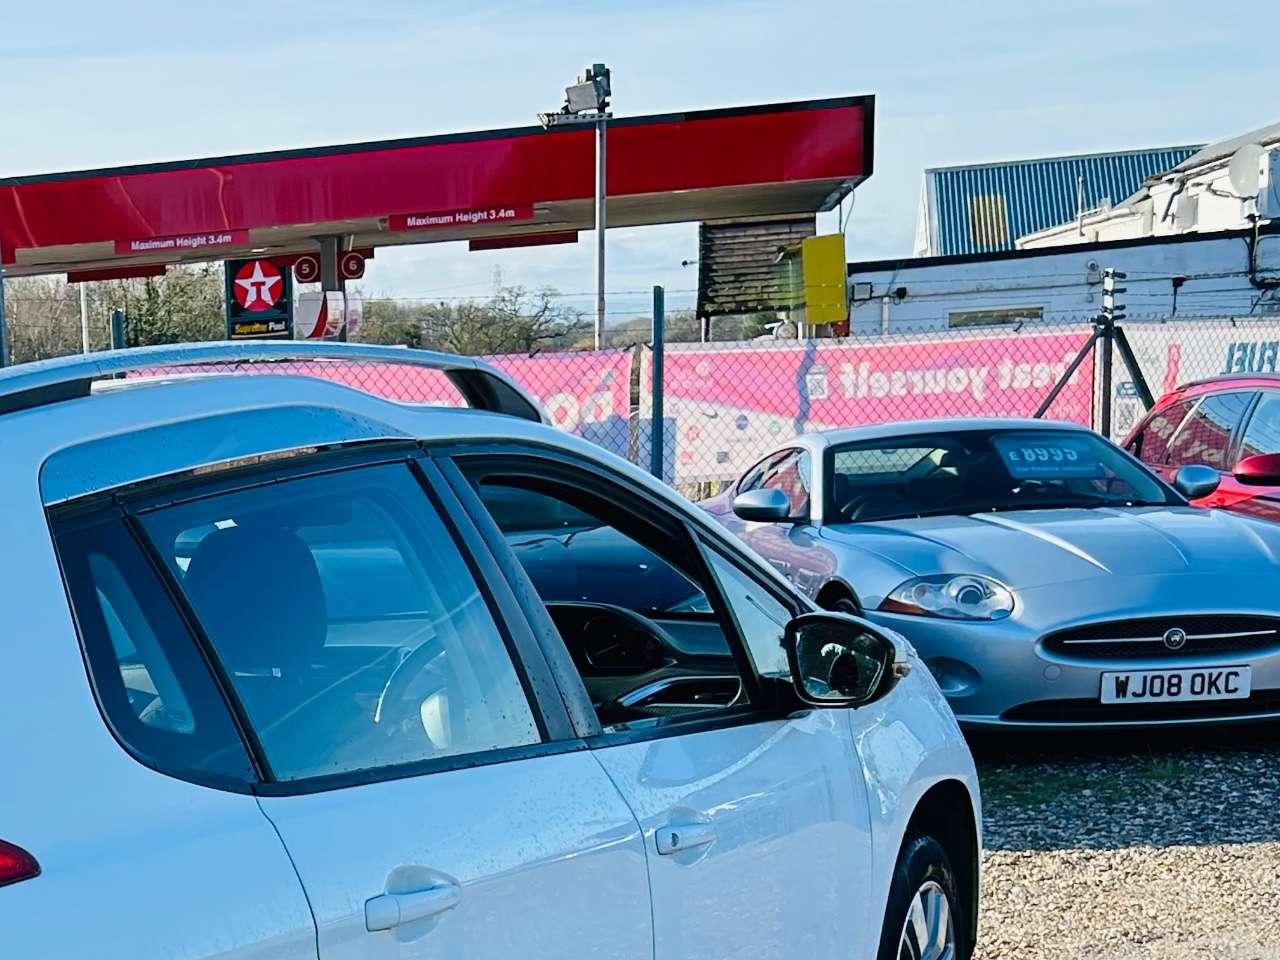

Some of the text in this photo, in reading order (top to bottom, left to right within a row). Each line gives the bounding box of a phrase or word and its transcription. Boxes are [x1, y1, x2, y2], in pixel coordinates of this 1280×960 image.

[407, 208, 516, 226] Maximum Height 3.4m
[131, 234, 232, 250] Maximum Height 3.4m
[301, 263, 310, 273] 5
[349, 261, 357, 270] 6
[1115, 671, 1240, 699] WJ08 OKC
